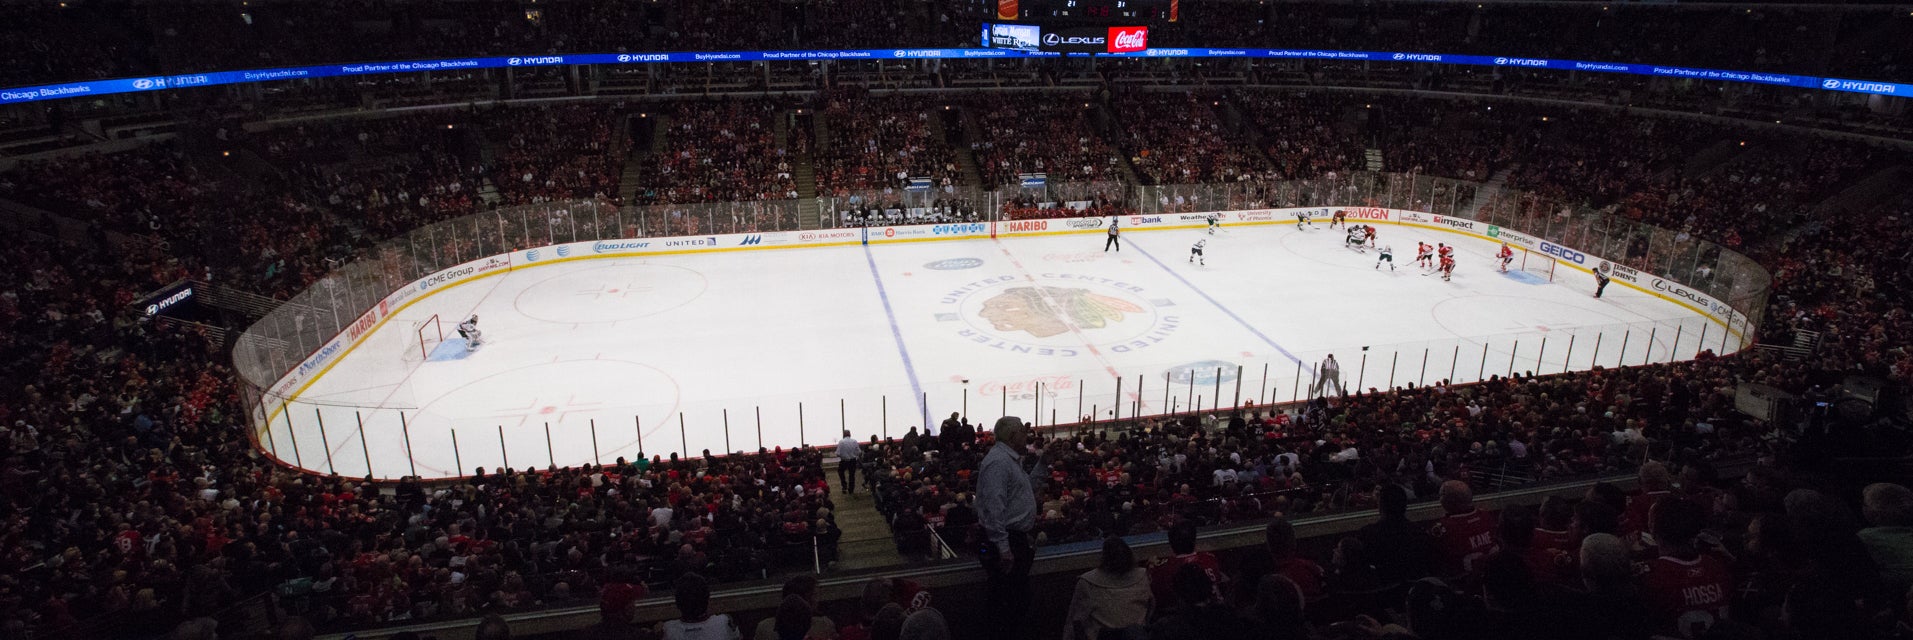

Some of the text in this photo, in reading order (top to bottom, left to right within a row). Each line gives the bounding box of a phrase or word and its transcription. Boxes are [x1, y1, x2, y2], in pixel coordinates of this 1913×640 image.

[992, 36, 1011, 45] WHITE
[524, 56, 563, 64] HYUNDAI
[632, 54, 669, 62] HYUNDAI
[817, 51, 839, 59] Chicago
[1509, 58, 1548, 66] HYUNDAI
[1576, 62, 1629, 71] BuyHyundai.com
[1674, 68, 1700, 76] Partner
[1708, 70, 1720, 78] the
[1721, 72, 1750, 80] Chicago
[156, 75, 208, 87] HYUNDAI
[1842, 81, 1896, 93] HYUNDAI
[0, 86, 91, 100] Chicago Blackhawks
[1358, 207, 1389, 220] WGN
[1009, 220, 1048, 232] HARIBO
[1440, 215, 1474, 230] impact
[619, 241, 651, 249] LIGHT
[666, 239, 705, 247] UNITED
[1539, 241, 1585, 265] GEICO
[427, 265, 474, 287] CME Group
[1613, 263, 1639, 276] JIMMY
[1612, 270, 1637, 283] JOHN'S
[941, 272, 1145, 305] UNITED CENTER
[159, 288, 192, 309] HYUNDAI
[1667, 284, 1708, 307] LEXUS
[350, 310, 377, 341] HARIBO
[1111, 315, 1180, 353] UNITED
[957, 328, 1078, 357] CENTER
[303, 340, 341, 371] NorthShore
[1469, 531, 1492, 550] KANE
[1682, 583, 1724, 605] HOSSA
